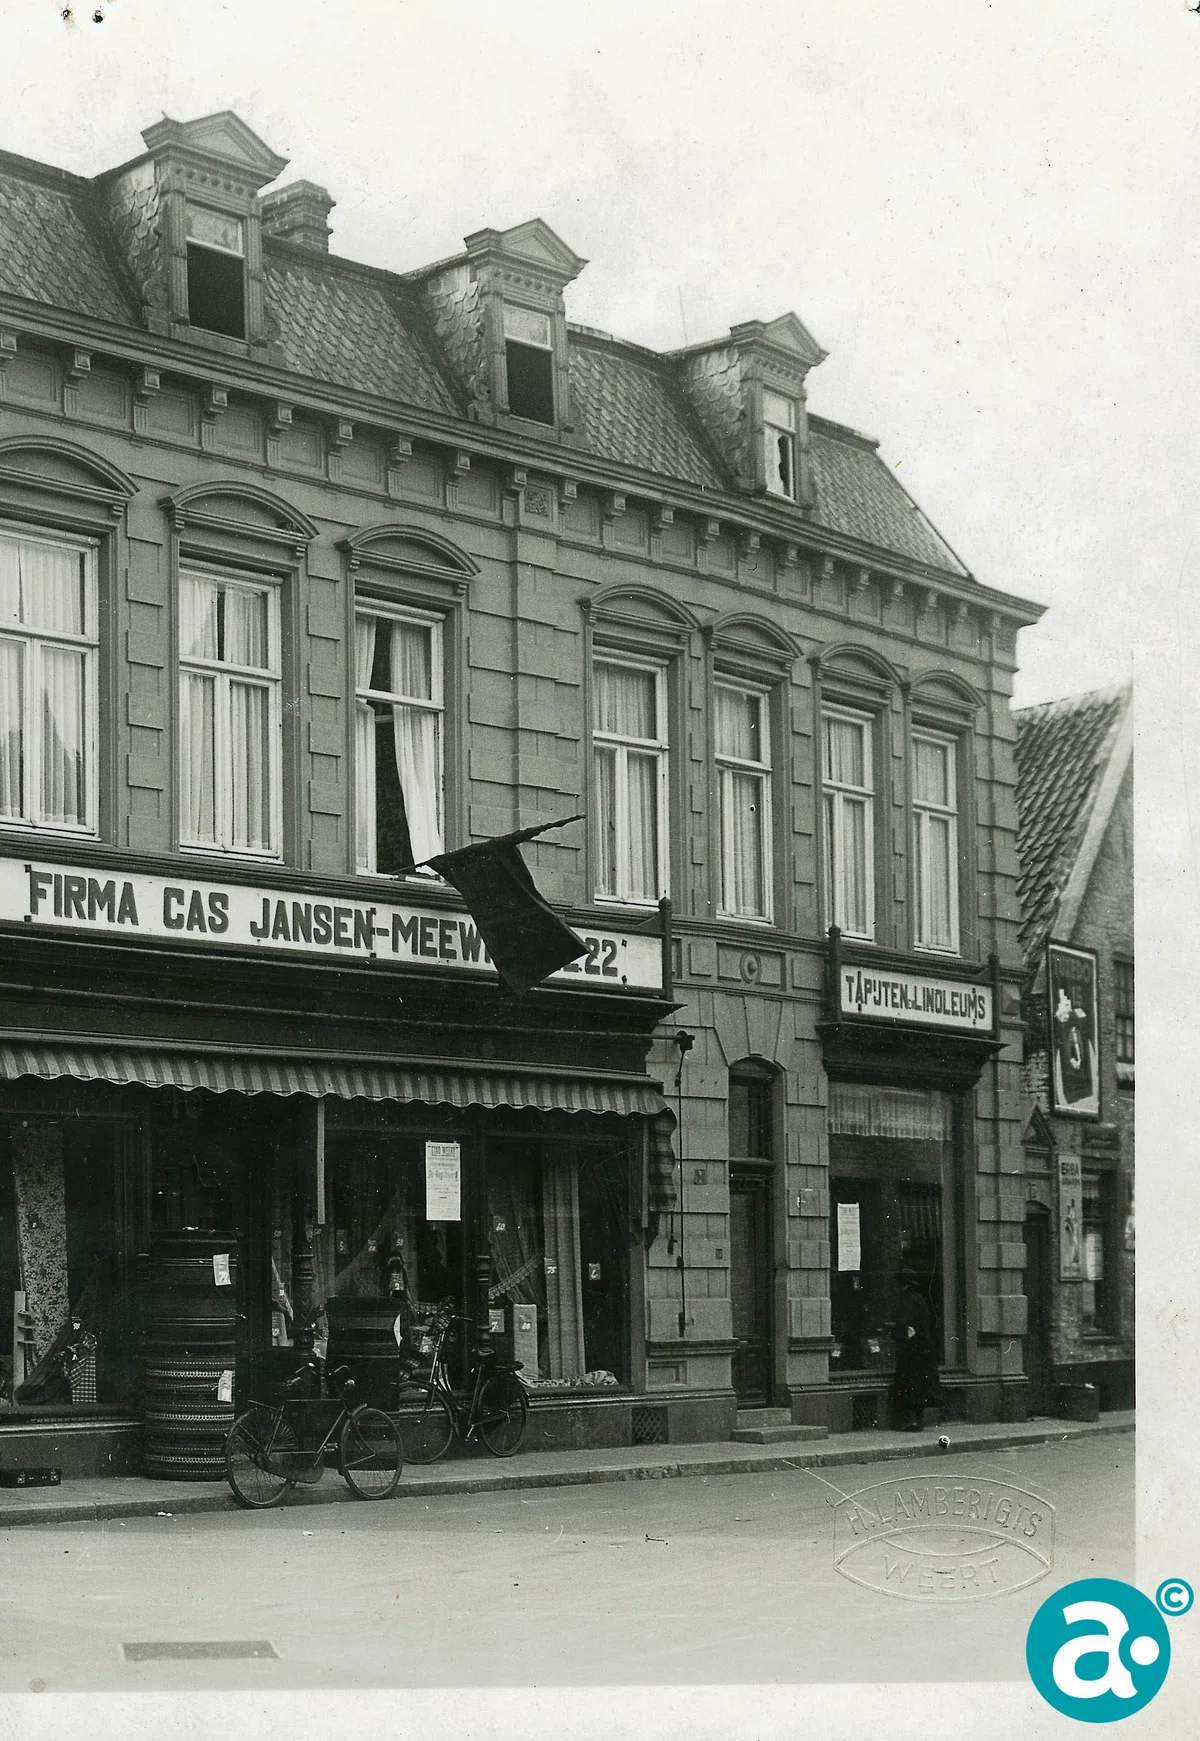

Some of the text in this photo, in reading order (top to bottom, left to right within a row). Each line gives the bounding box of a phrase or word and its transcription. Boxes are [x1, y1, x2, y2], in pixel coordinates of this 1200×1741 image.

[30, 870, 139, 926] FIRMA
[163, 887, 229, 934] CAS
[250, 898, 493, 964] JANSEN-MEEW
